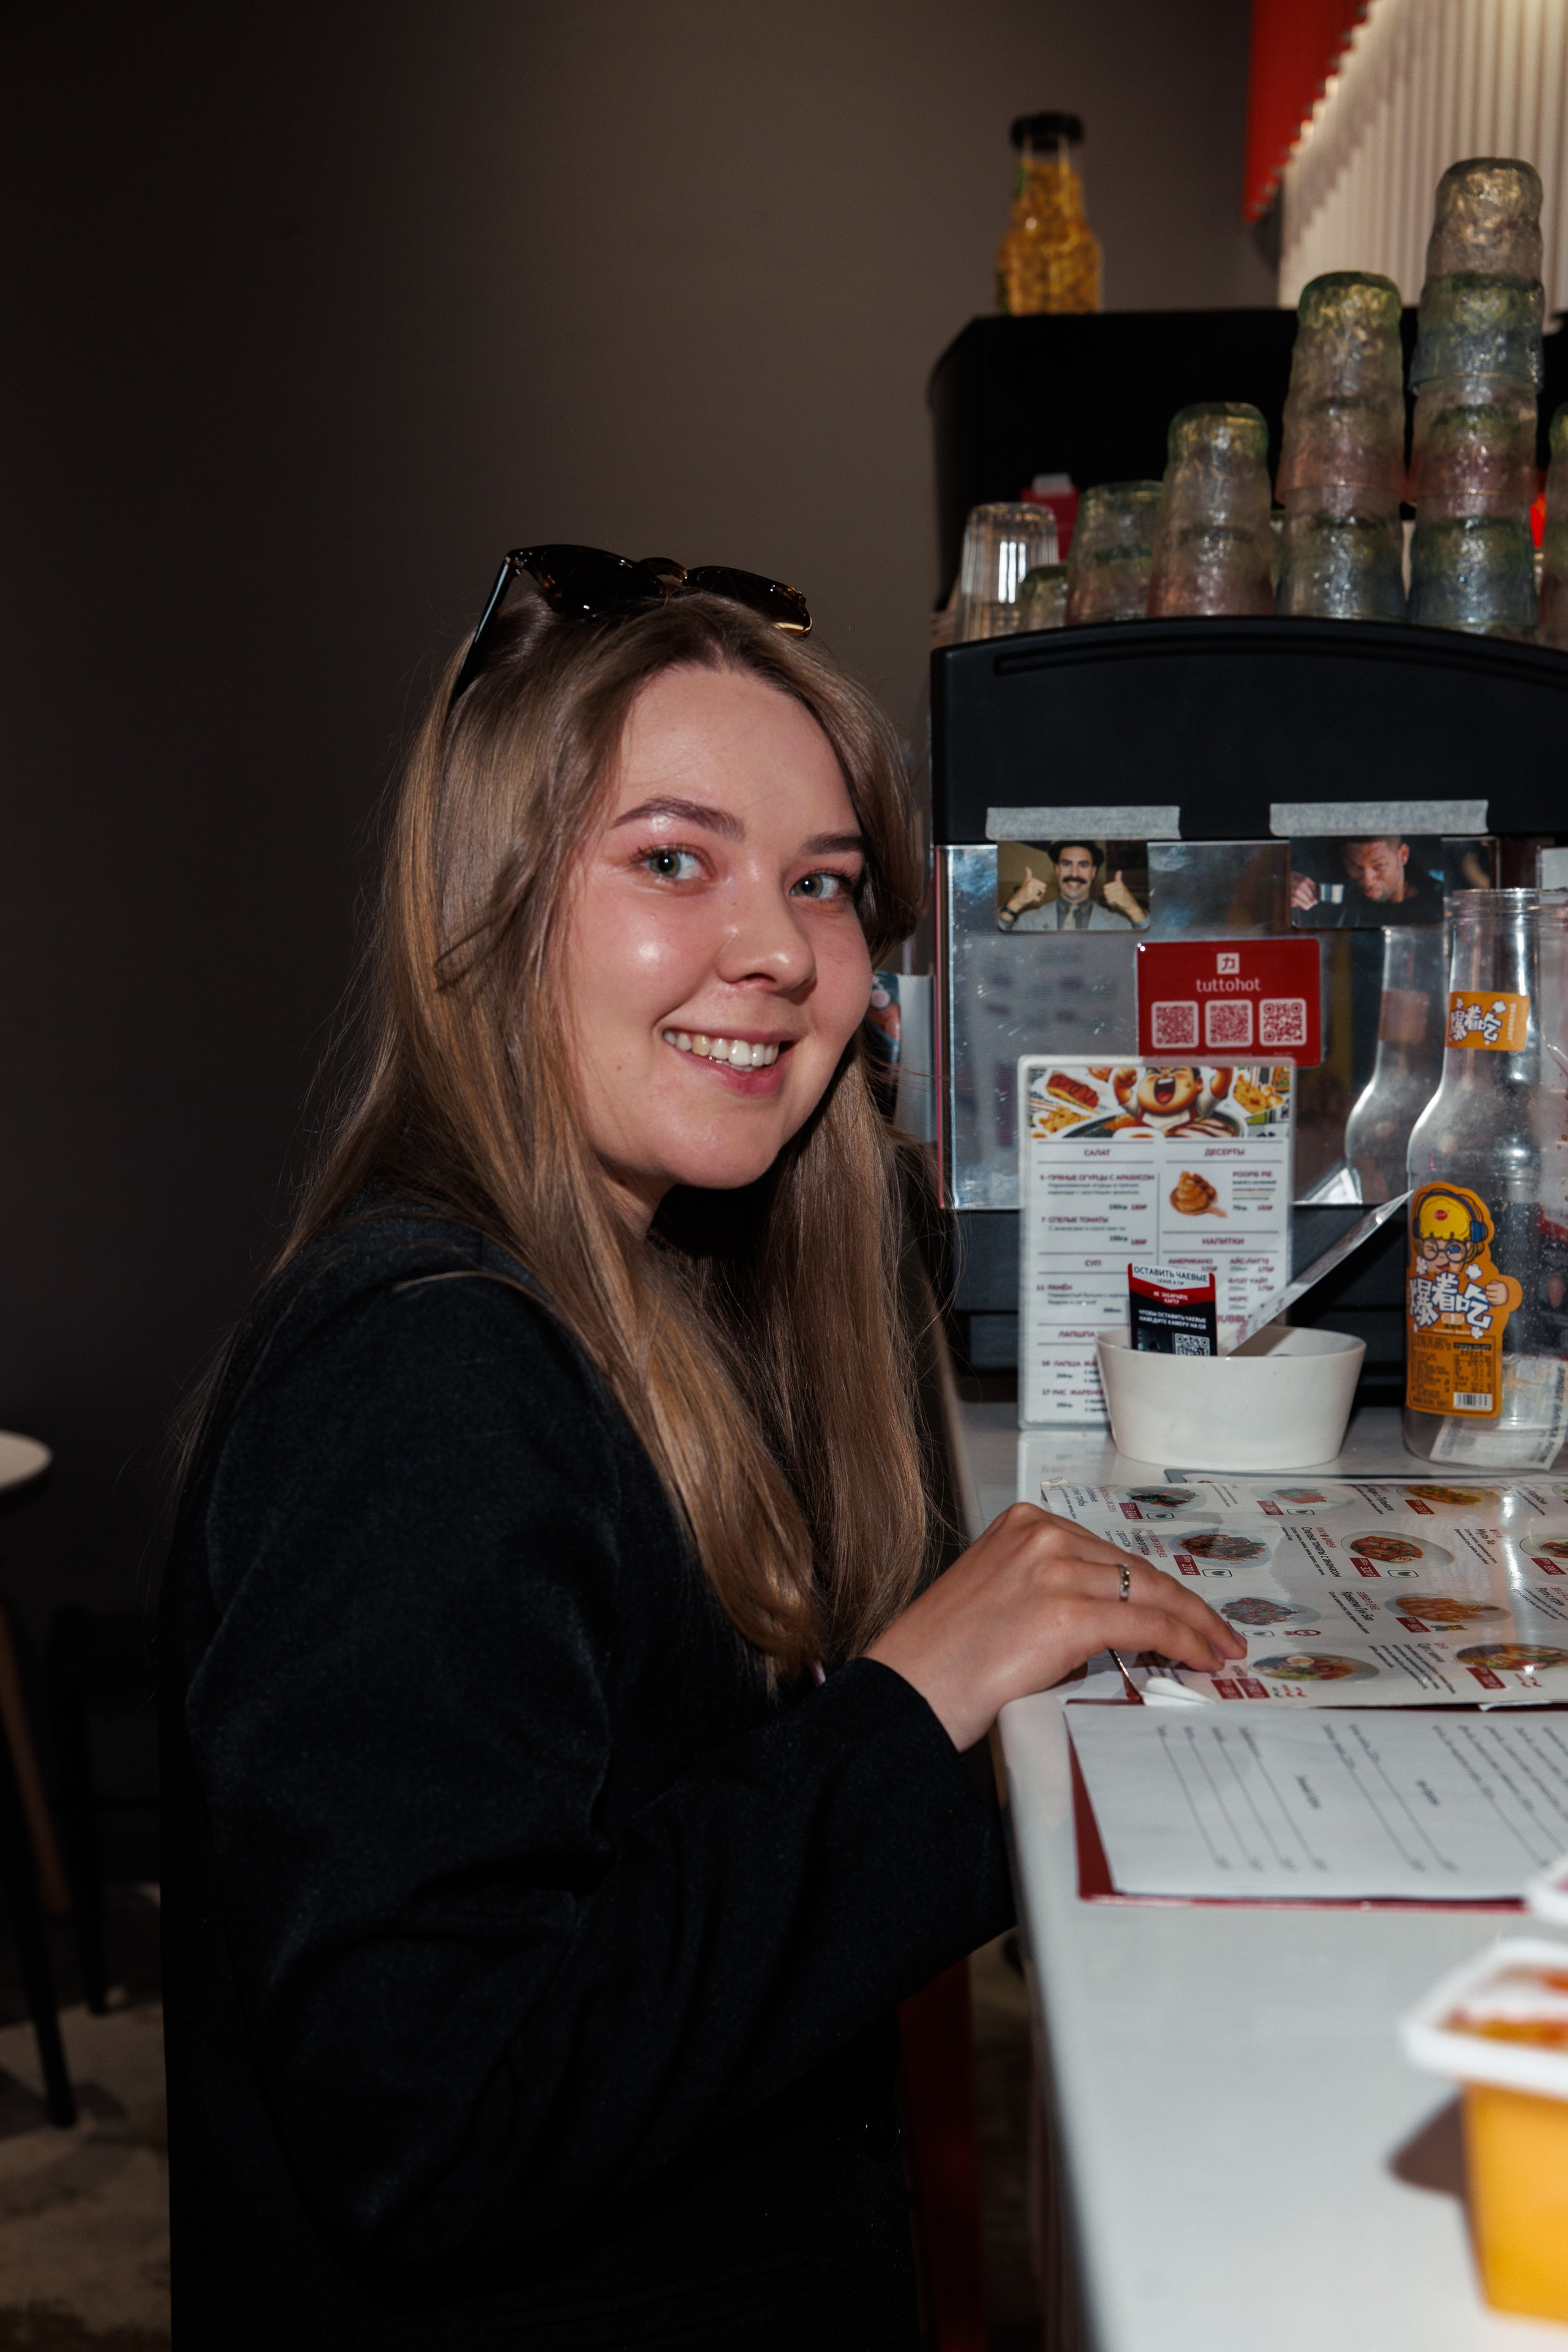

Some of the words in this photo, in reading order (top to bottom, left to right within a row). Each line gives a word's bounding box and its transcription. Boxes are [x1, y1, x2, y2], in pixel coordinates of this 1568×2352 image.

[1196, 977, 1262, 993] tuttohot
[1205, 1148, 1245, 1156] ДЕСЕРТЫ
[1134, 1266, 1174, 1278] ОСТАВИТЬ
[1176, 1272, 1208, 1282] ЧАЕВЫЕ
[1409, 1272, 1493, 1330] 爆着吃
[1158, 1311, 1184, 1321] ОСТАВИТЬ
[1115, 1532, 1134, 1547] арахисом
[1129, 1530, 1148, 1542] Пряные
[1300, 1527, 1321, 1540] Спелые
[1134, 1542, 1153, 1555] огурцы
[1309, 1541, 1328, 1555] томаты
[1320, 1558, 1343, 1577] ананасом
